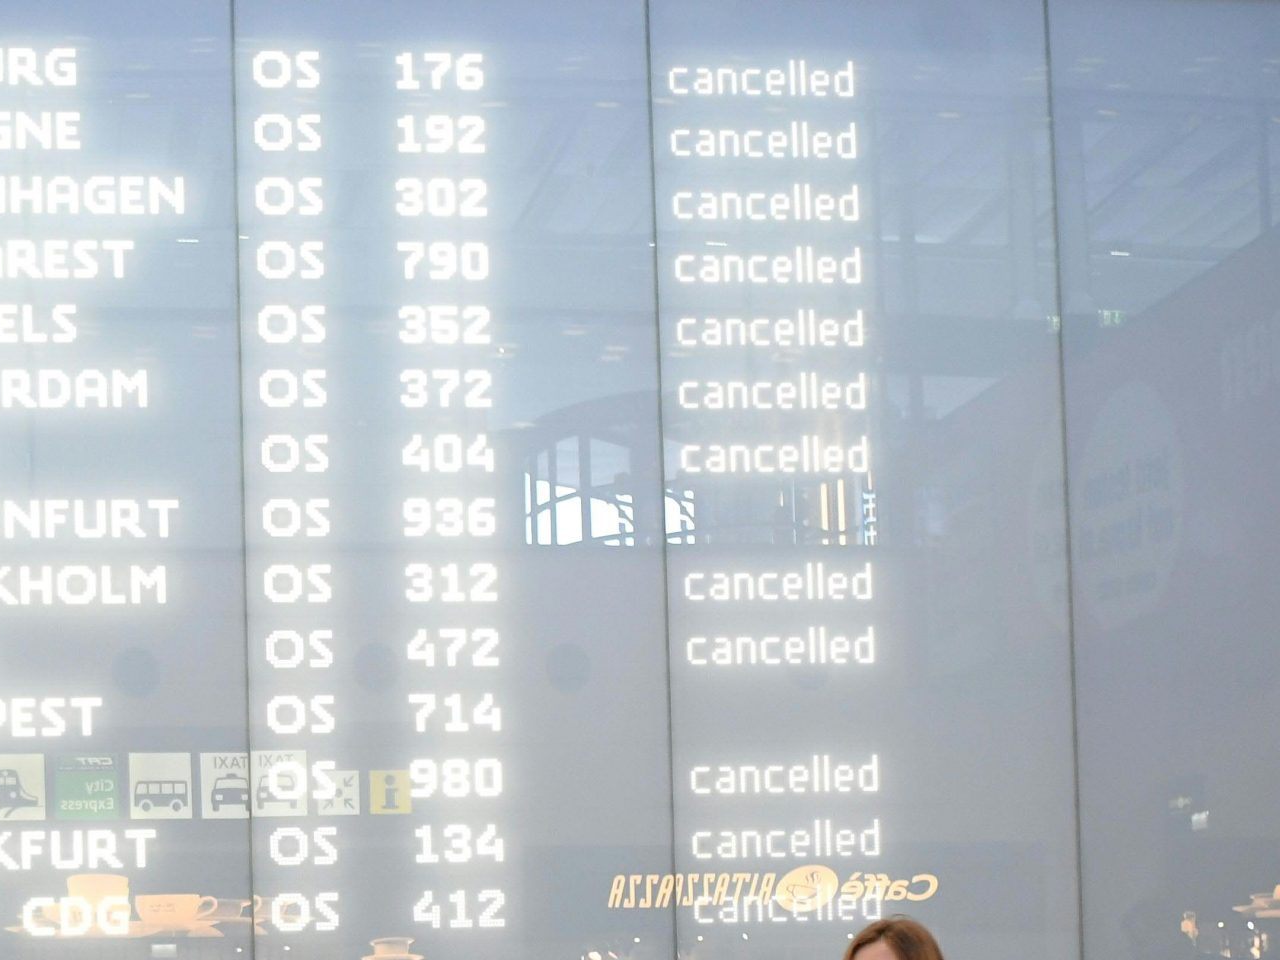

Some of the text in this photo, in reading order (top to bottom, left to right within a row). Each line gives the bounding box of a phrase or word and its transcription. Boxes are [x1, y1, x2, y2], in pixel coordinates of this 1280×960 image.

[253, 51, 319, 88] OS
[396, 53, 483, 90] 176
[670, 61, 853, 96] cancelled
[255, 114, 321, 150] OS
[398, 115, 485, 153] 192
[671, 122, 856, 158] cancelled
[256, 177, 322, 215] OS
[396, 178, 487, 216] 302
[674, 184, 859, 220] cancelled
[257, 241, 324, 278] OS
[398, 242, 488, 280] 790
[676, 246, 861, 283] cancelled
[259, 305, 325, 343] OS
[399, 306, 491, 344] 352
[678, 310, 863, 346] cancelled
[260, 370, 326, 407] OS
[401, 370, 491, 407] 372
[680, 373, 865, 409] cancelled
[262, 435, 328, 472] OS
[403, 434, 494, 472] 404
[681, 436, 868, 473] cancelled
[263, 499, 329, 536] OS
[404, 498, 495, 536] 936
[264, 565, 331, 602] OS
[406, 563, 497, 601] 312
[685, 563, 871, 600] cancelled
[266, 630, 332, 667] OS
[408, 629, 498, 666] 472
[688, 627, 874, 664] cancelled
[267, 696, 334, 733] OS
[409, 694, 500, 731] 714
[268, 761, 336, 799] OS
[410, 759, 502, 797] 980
[691, 755, 878, 793] cancelled
[270, 827, 337, 865] OS
[416, 824, 503, 862] 134
[693, 820, 879, 858] cancelled
[23, 897, 128, 936] CDG
[272, 893, 338, 931] OS
[414, 890, 504, 928] 412
[695, 886, 881, 923] cancelled
